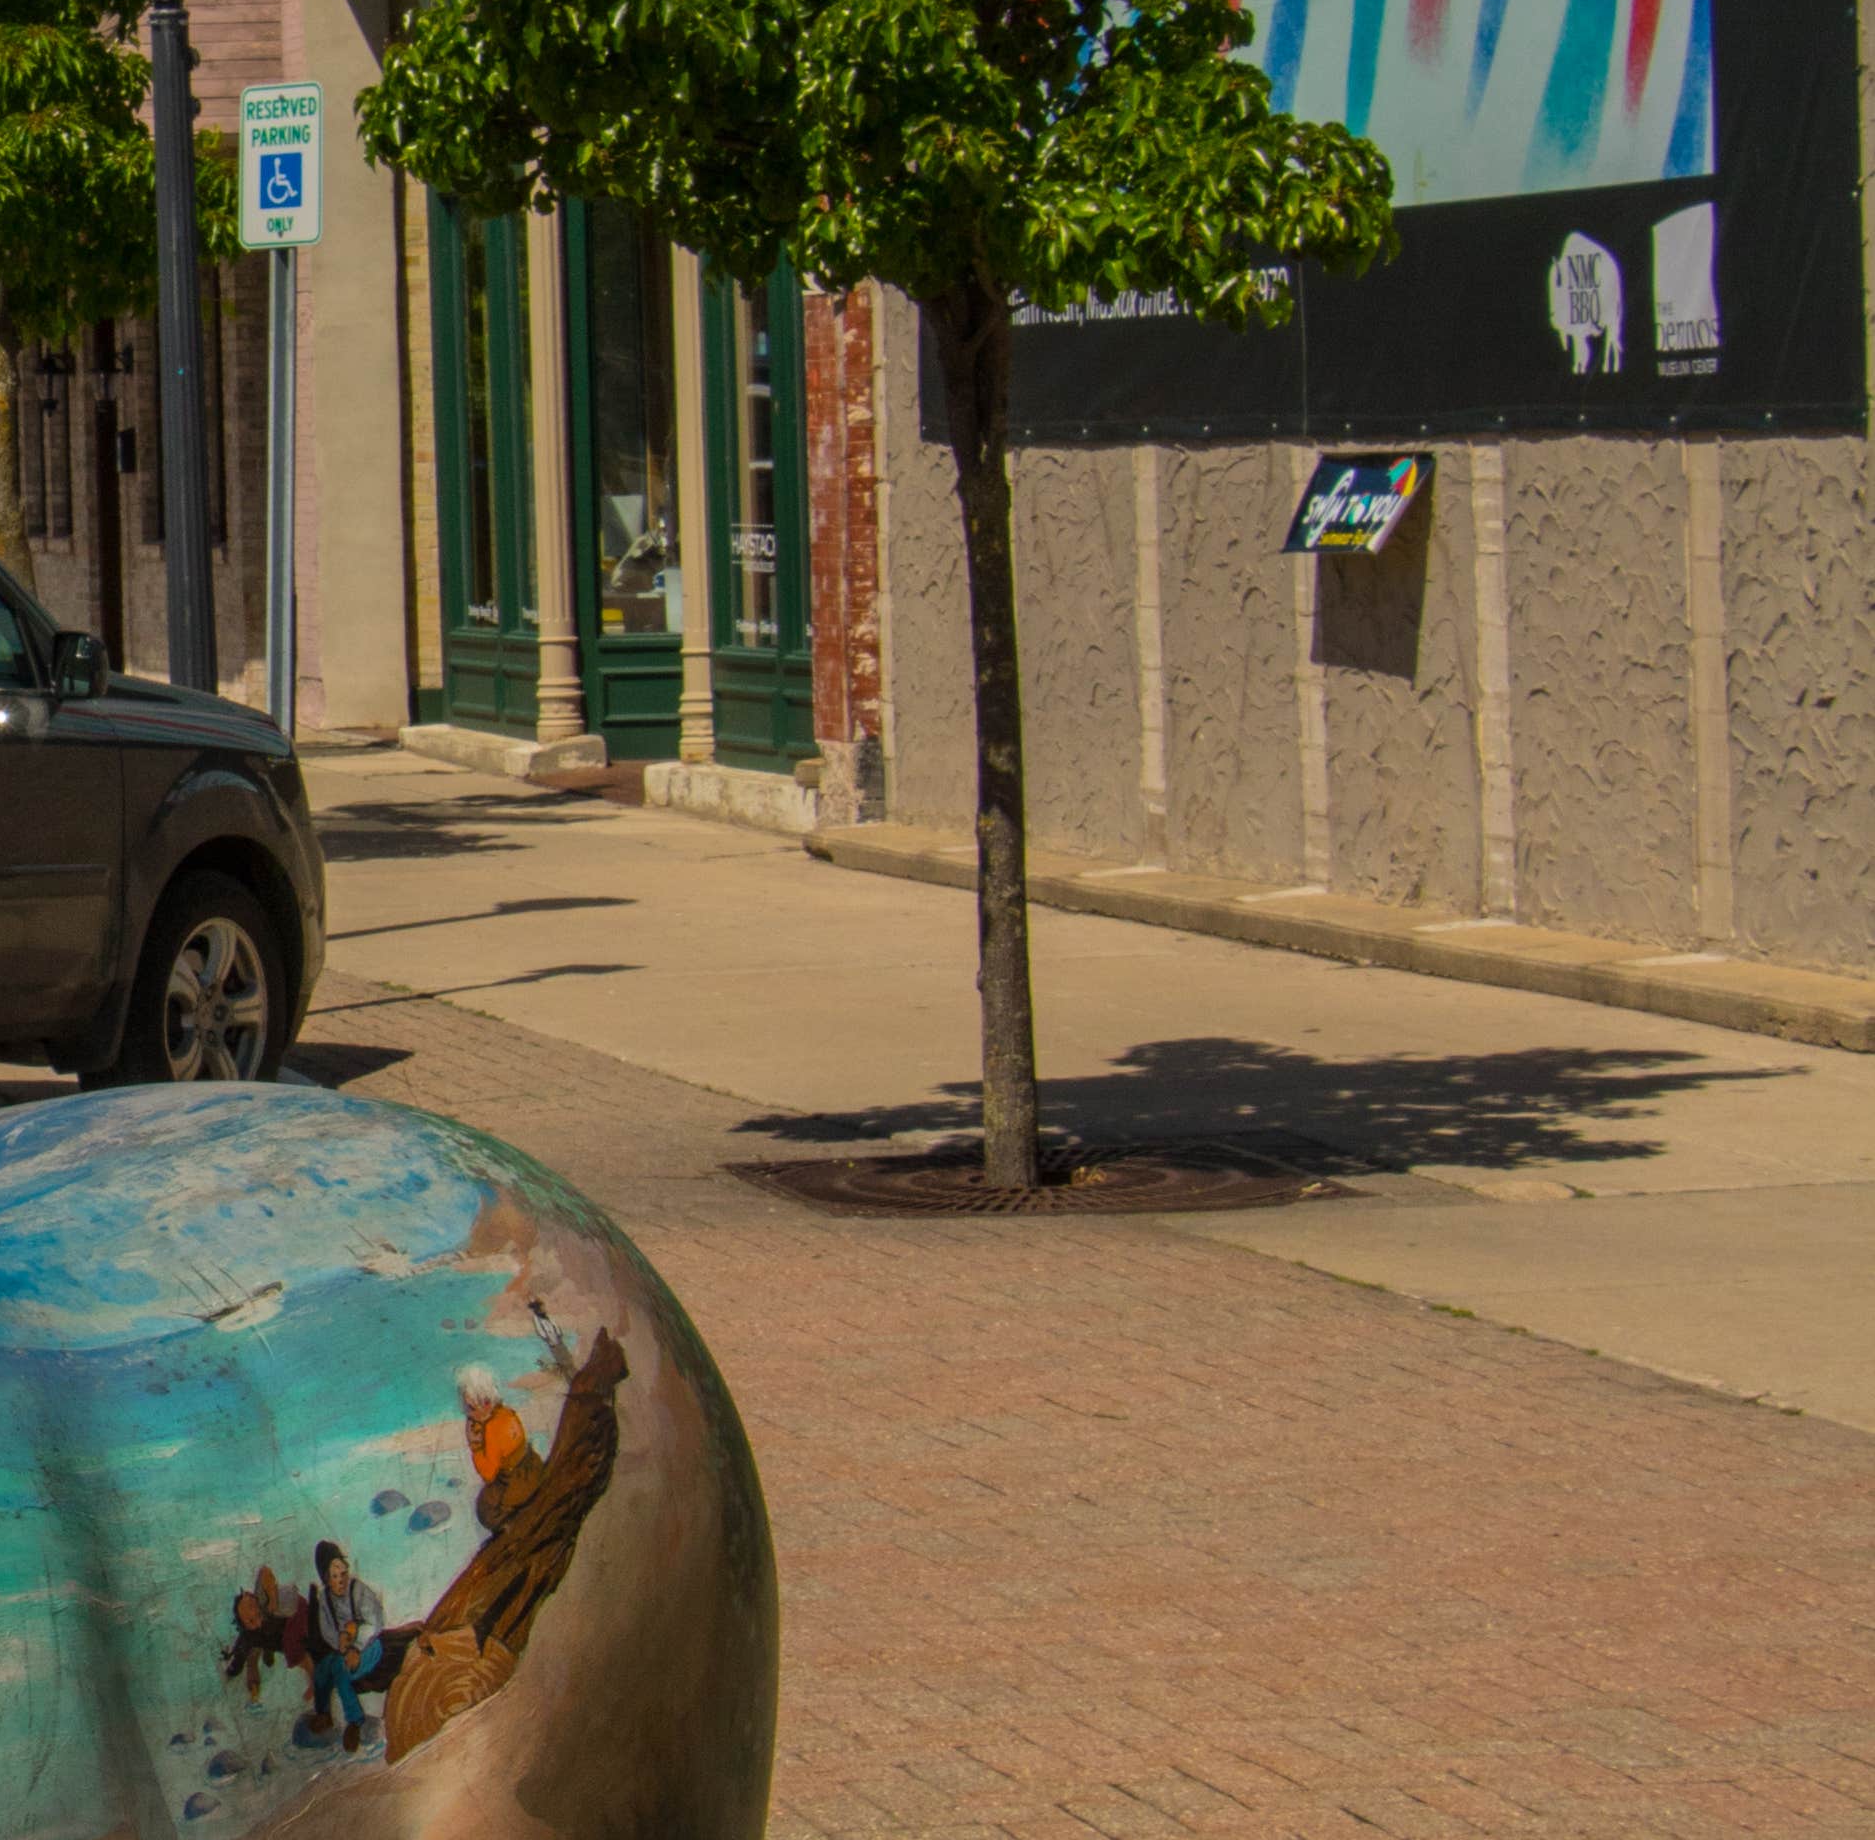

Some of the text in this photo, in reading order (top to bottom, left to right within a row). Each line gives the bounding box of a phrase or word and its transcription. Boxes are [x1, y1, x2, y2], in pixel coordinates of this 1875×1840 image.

[246, 97, 317, 120] RESERVED
[251, 125, 311, 147] PARKING
[266, 216, 294, 233] ONLY
[1567, 252, 1602, 290] NMC
[1569, 289, 1603, 330] BBQ
